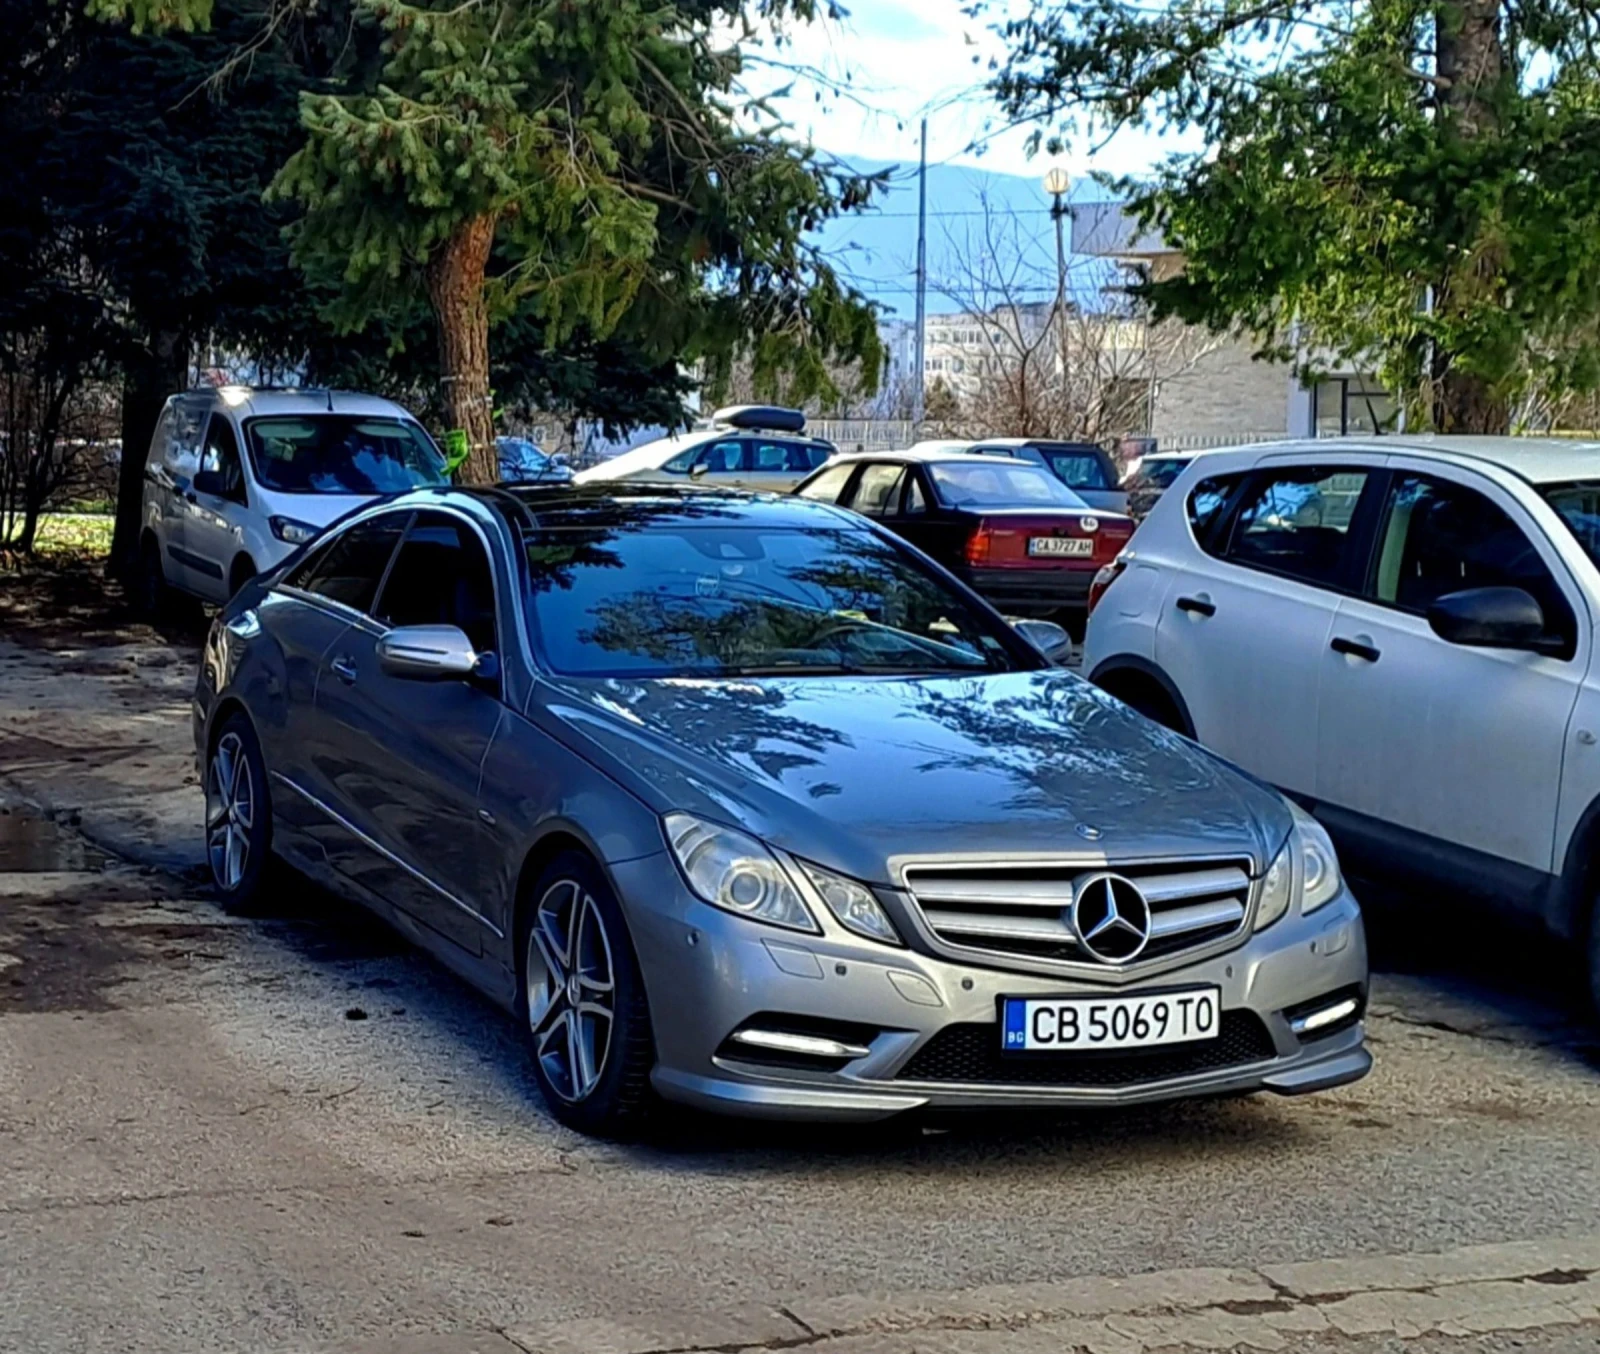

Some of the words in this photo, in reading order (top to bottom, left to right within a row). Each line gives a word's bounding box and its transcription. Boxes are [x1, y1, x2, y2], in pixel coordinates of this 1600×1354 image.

[1036, 539, 1049, 551] CA
[1051, 540, 1077, 552] 3727
[1032, 1006, 1080, 1043] CB
[1088, 1002, 1169, 1041] 5069
[1177, 996, 1213, 1035] TO
[1008, 1031, 1024, 1043] BG
